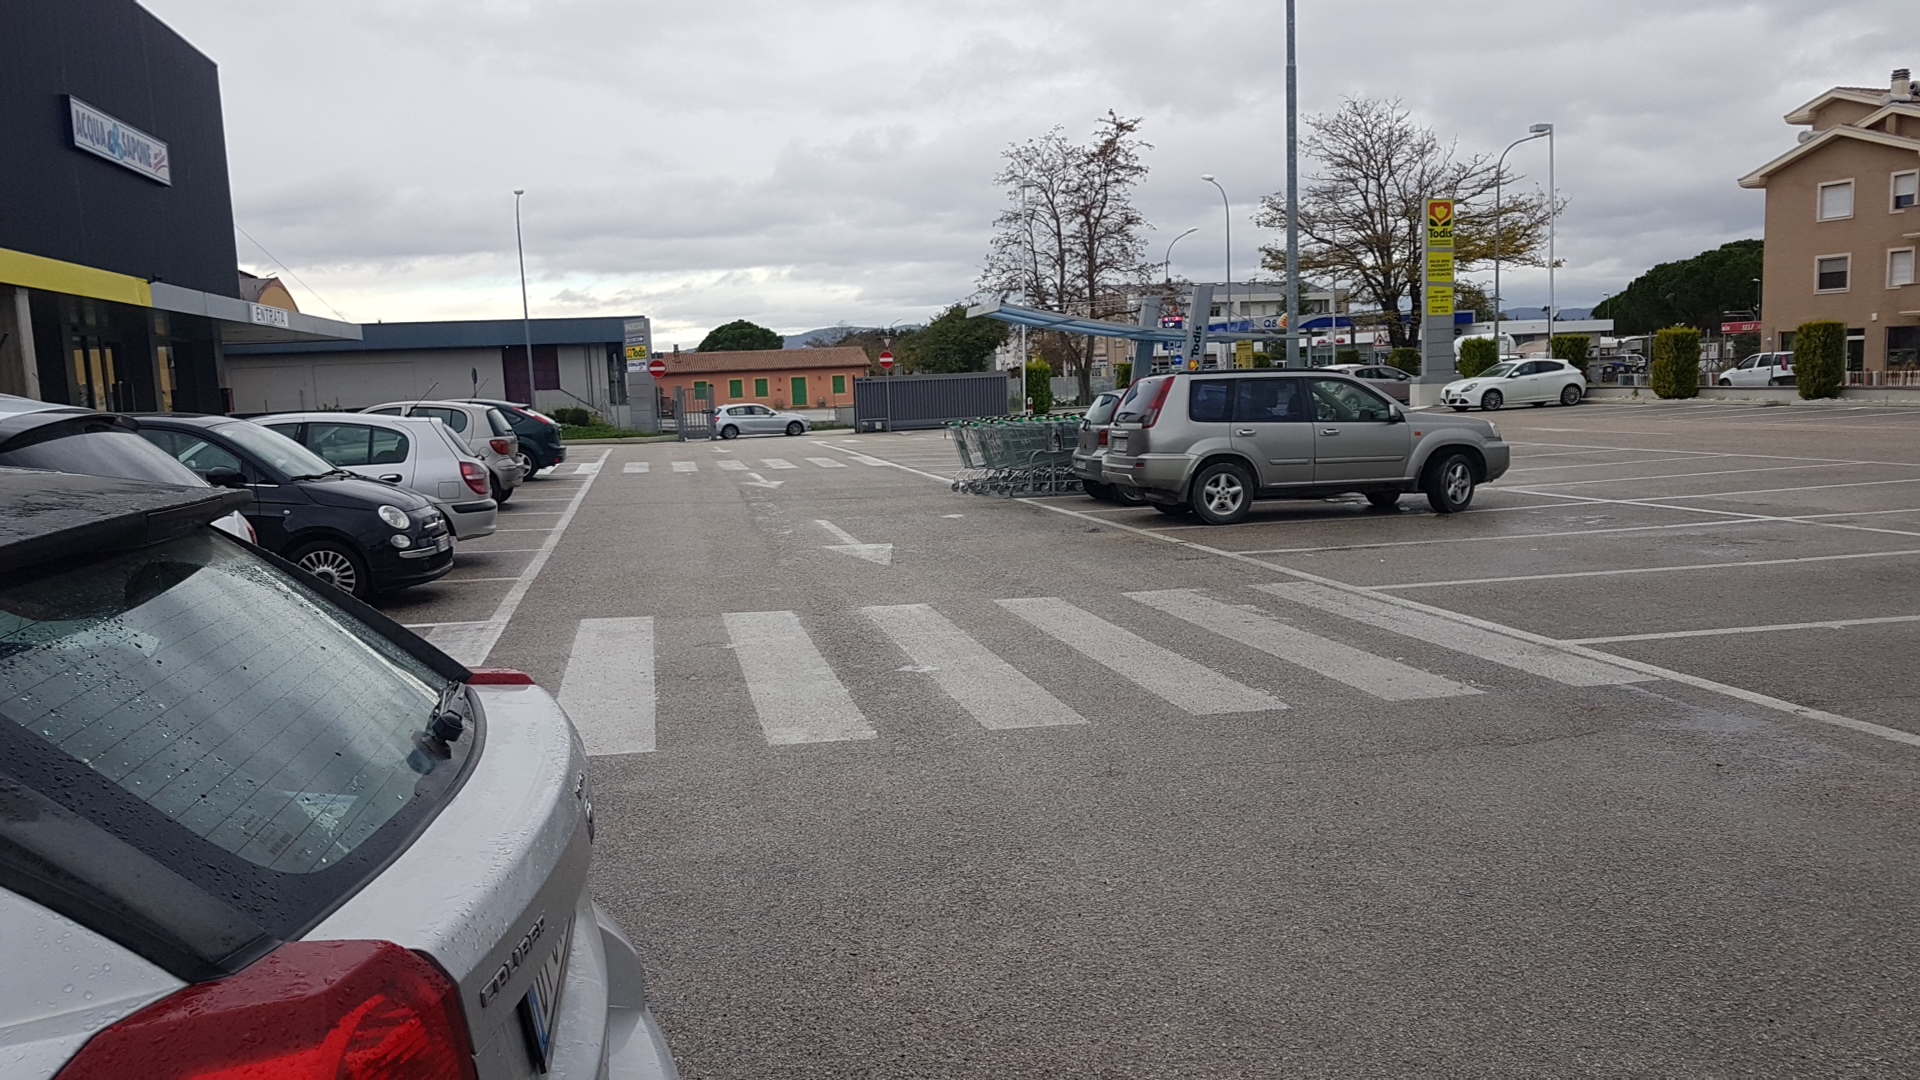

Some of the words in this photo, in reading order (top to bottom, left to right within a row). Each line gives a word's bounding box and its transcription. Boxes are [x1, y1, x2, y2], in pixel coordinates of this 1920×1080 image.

[75, 109, 107, 147] ACQUA
[1428, 228, 1453, 238] Todis
[256, 306, 286, 326] ENTRATA
[1263, 319, 1277, 328] Q8
[1191, 325, 1202, 357] Todis
